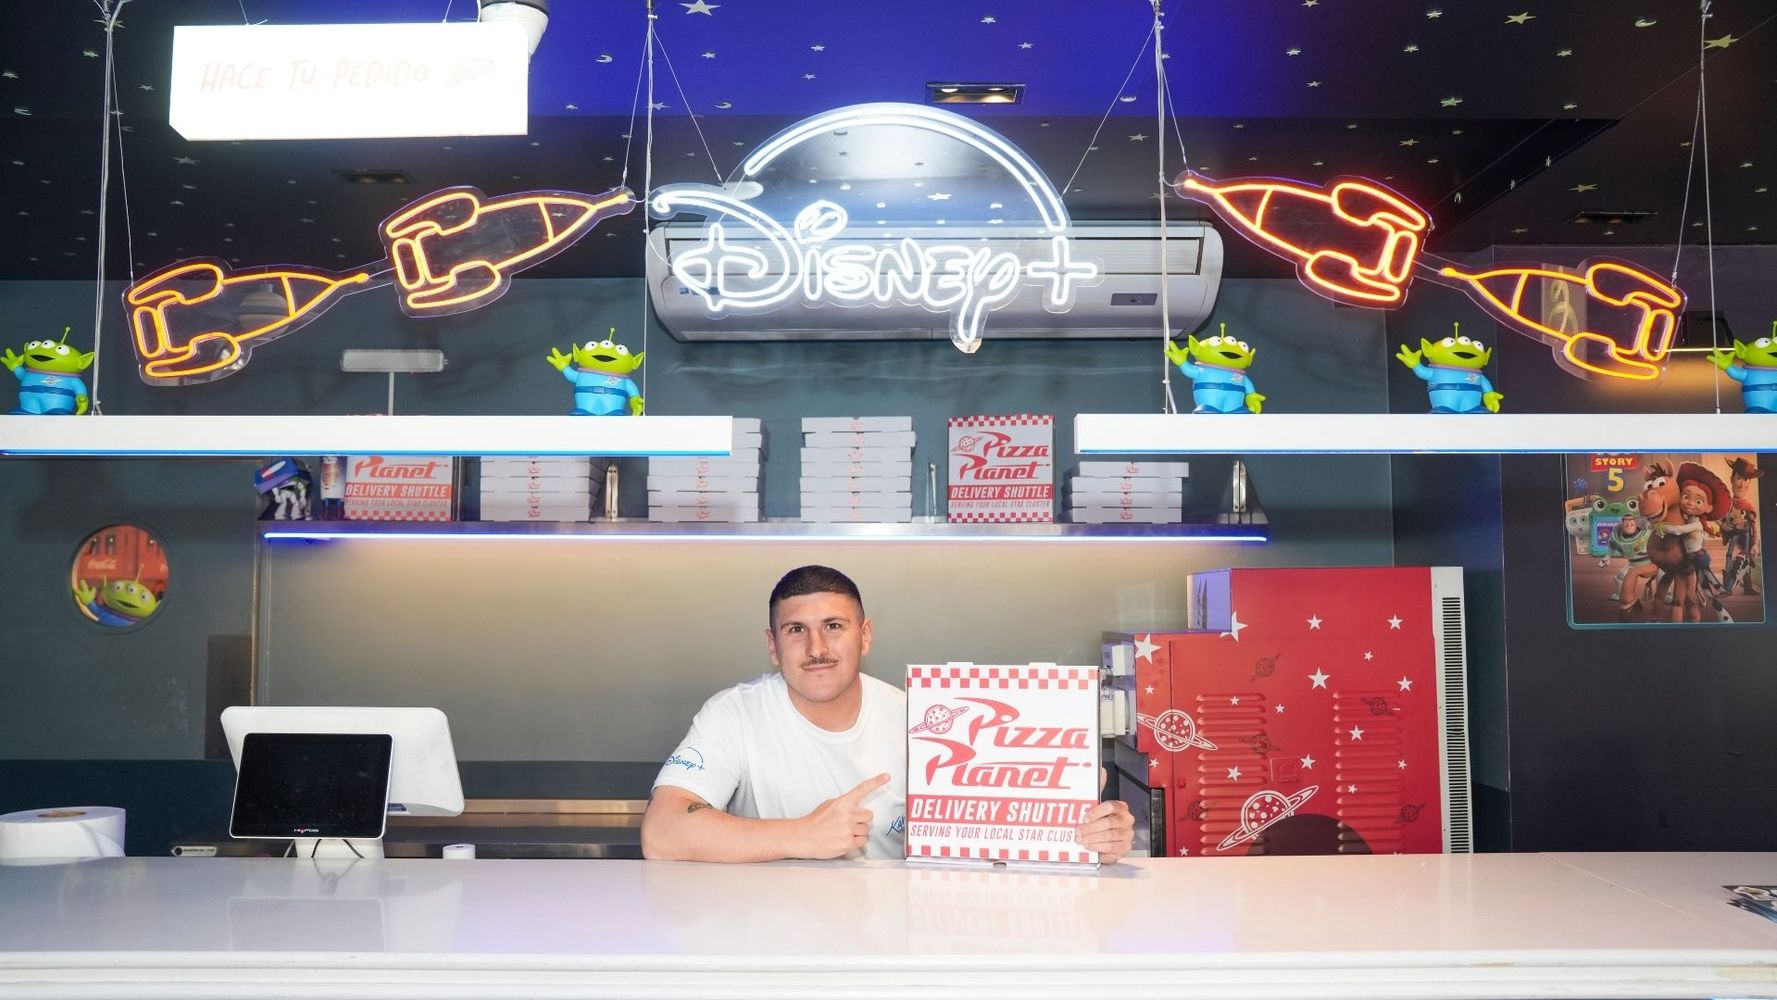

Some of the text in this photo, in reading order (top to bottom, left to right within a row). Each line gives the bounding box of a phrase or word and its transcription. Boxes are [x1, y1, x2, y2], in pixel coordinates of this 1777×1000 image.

[199, 59, 430, 92] HACE TU PEDIDO
[977, 430, 1050, 457] Pizza
[952, 453, 1045, 480] Planet
[1594, 457, 1634, 467] STORY
[346, 483, 447, 498] DELIVERY SHUTTLE
[950, 485, 1050, 499] DELIVERY SHUTTLE
[1607, 467, 1625, 493] 5
[953, 696, 1090, 749] Pizza
[911, 736, 1081, 790] Planet
[911, 798, 1001, 822] DELIVERY
[910, 824, 952, 838] SERVING
[955, 825, 981, 839] YOUR
[983, 827, 1014, 841] LOCAL
[1018, 828, 1044, 842] STAR
[1046, 829, 1077, 843] CLUS
